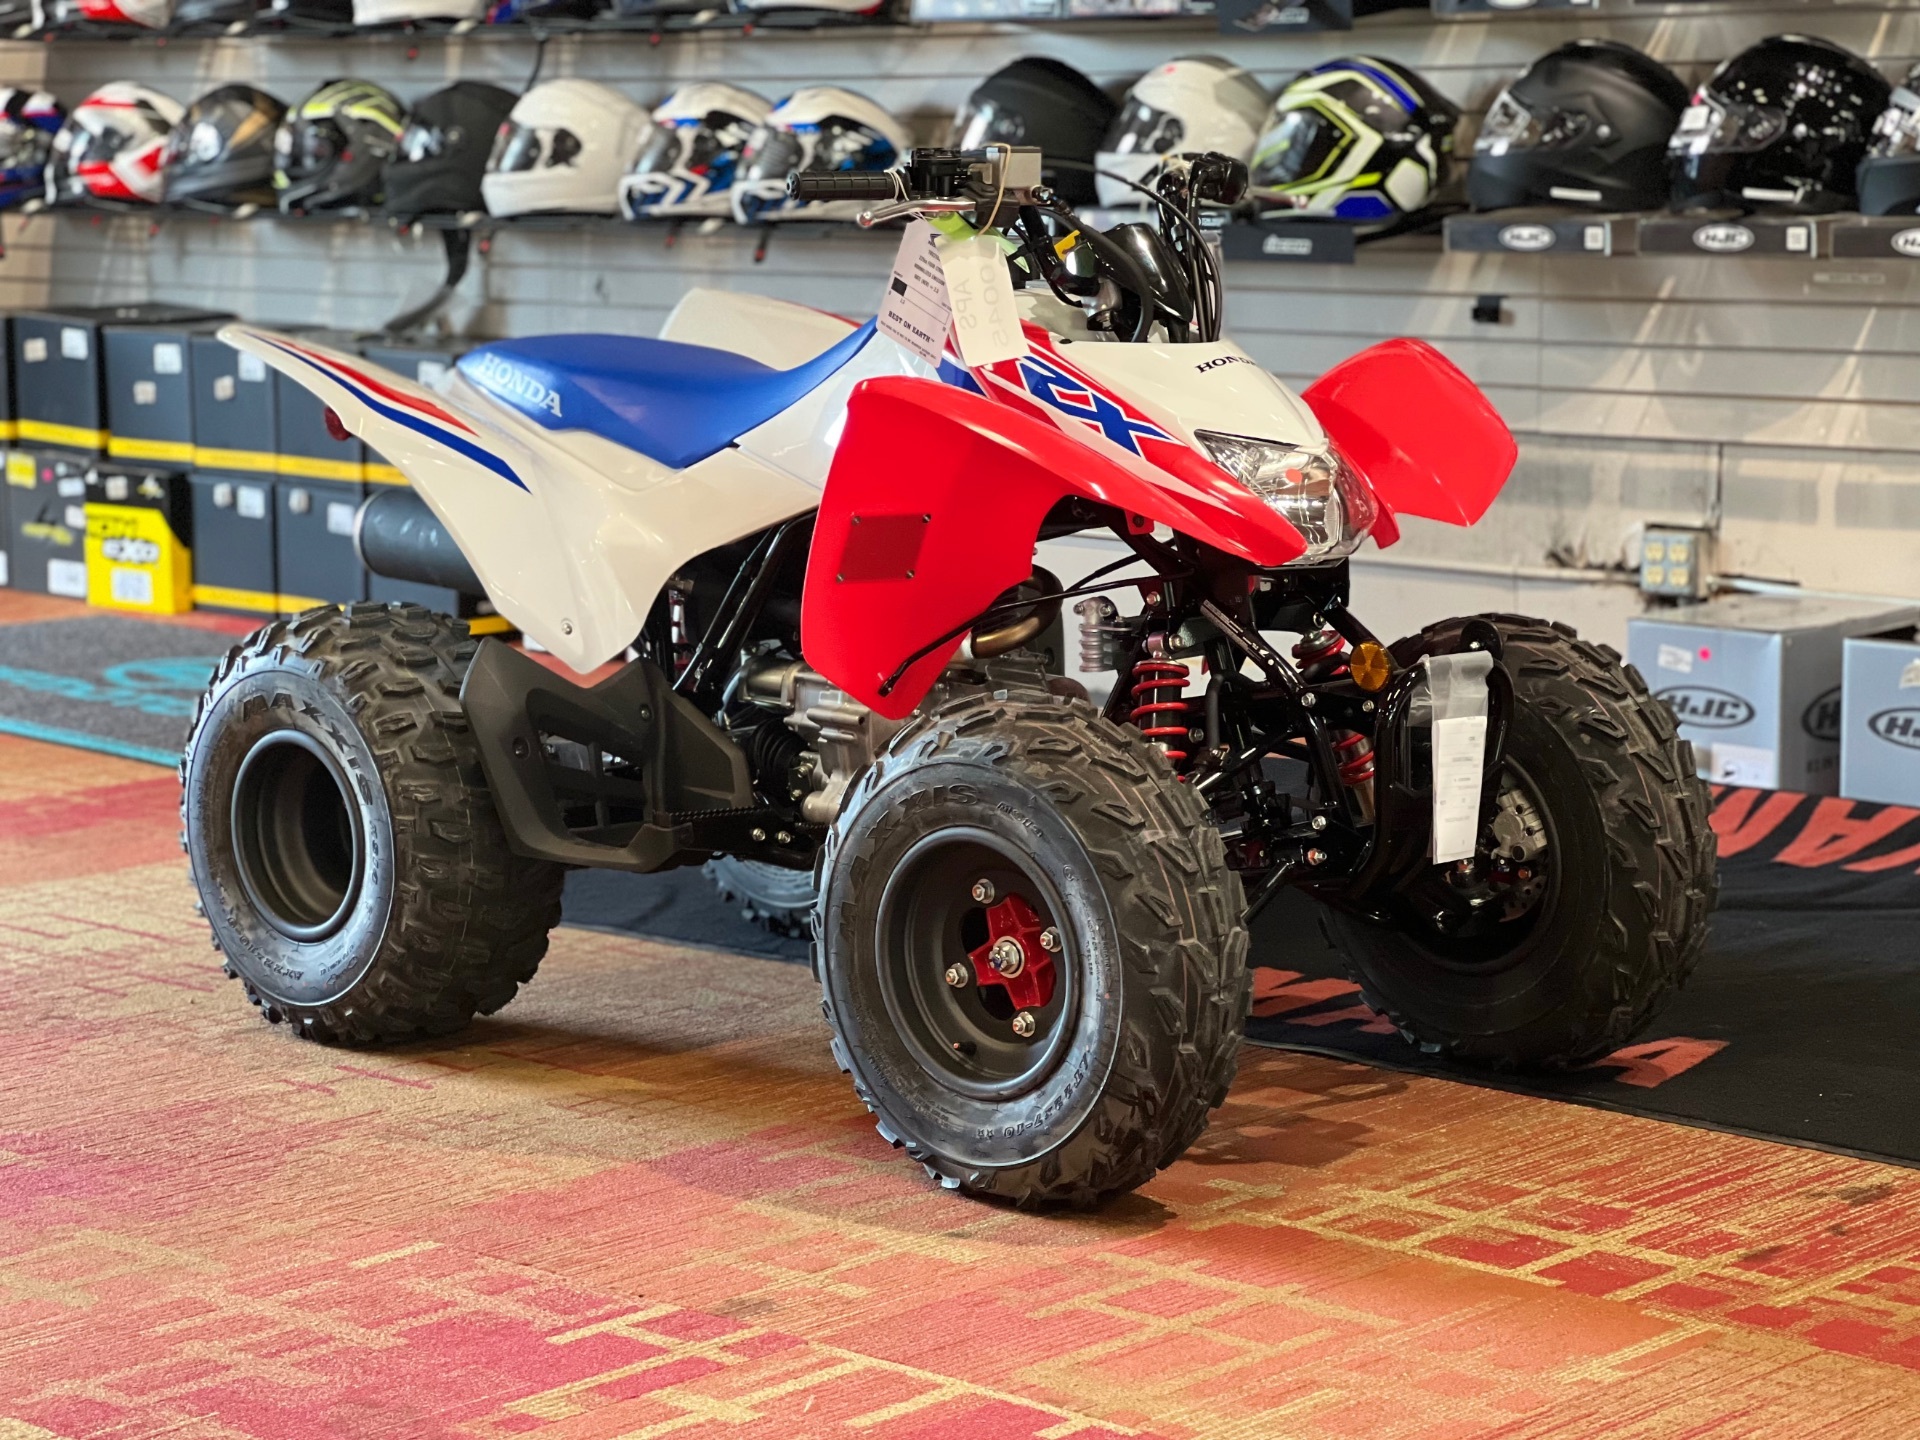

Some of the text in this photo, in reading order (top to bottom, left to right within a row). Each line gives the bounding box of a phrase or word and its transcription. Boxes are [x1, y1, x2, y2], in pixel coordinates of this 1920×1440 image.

[888, 310, 903, 324] BEST
[903, 320, 912, 331] ON
[481, 352, 562, 417] HONDA
[1195, 356, 1256, 374] HONDA
[1666, 694, 1742, 720] HJC
[243, 692, 374, 806] MAXXIS
[840, 783, 978, 944] MAXXIS
